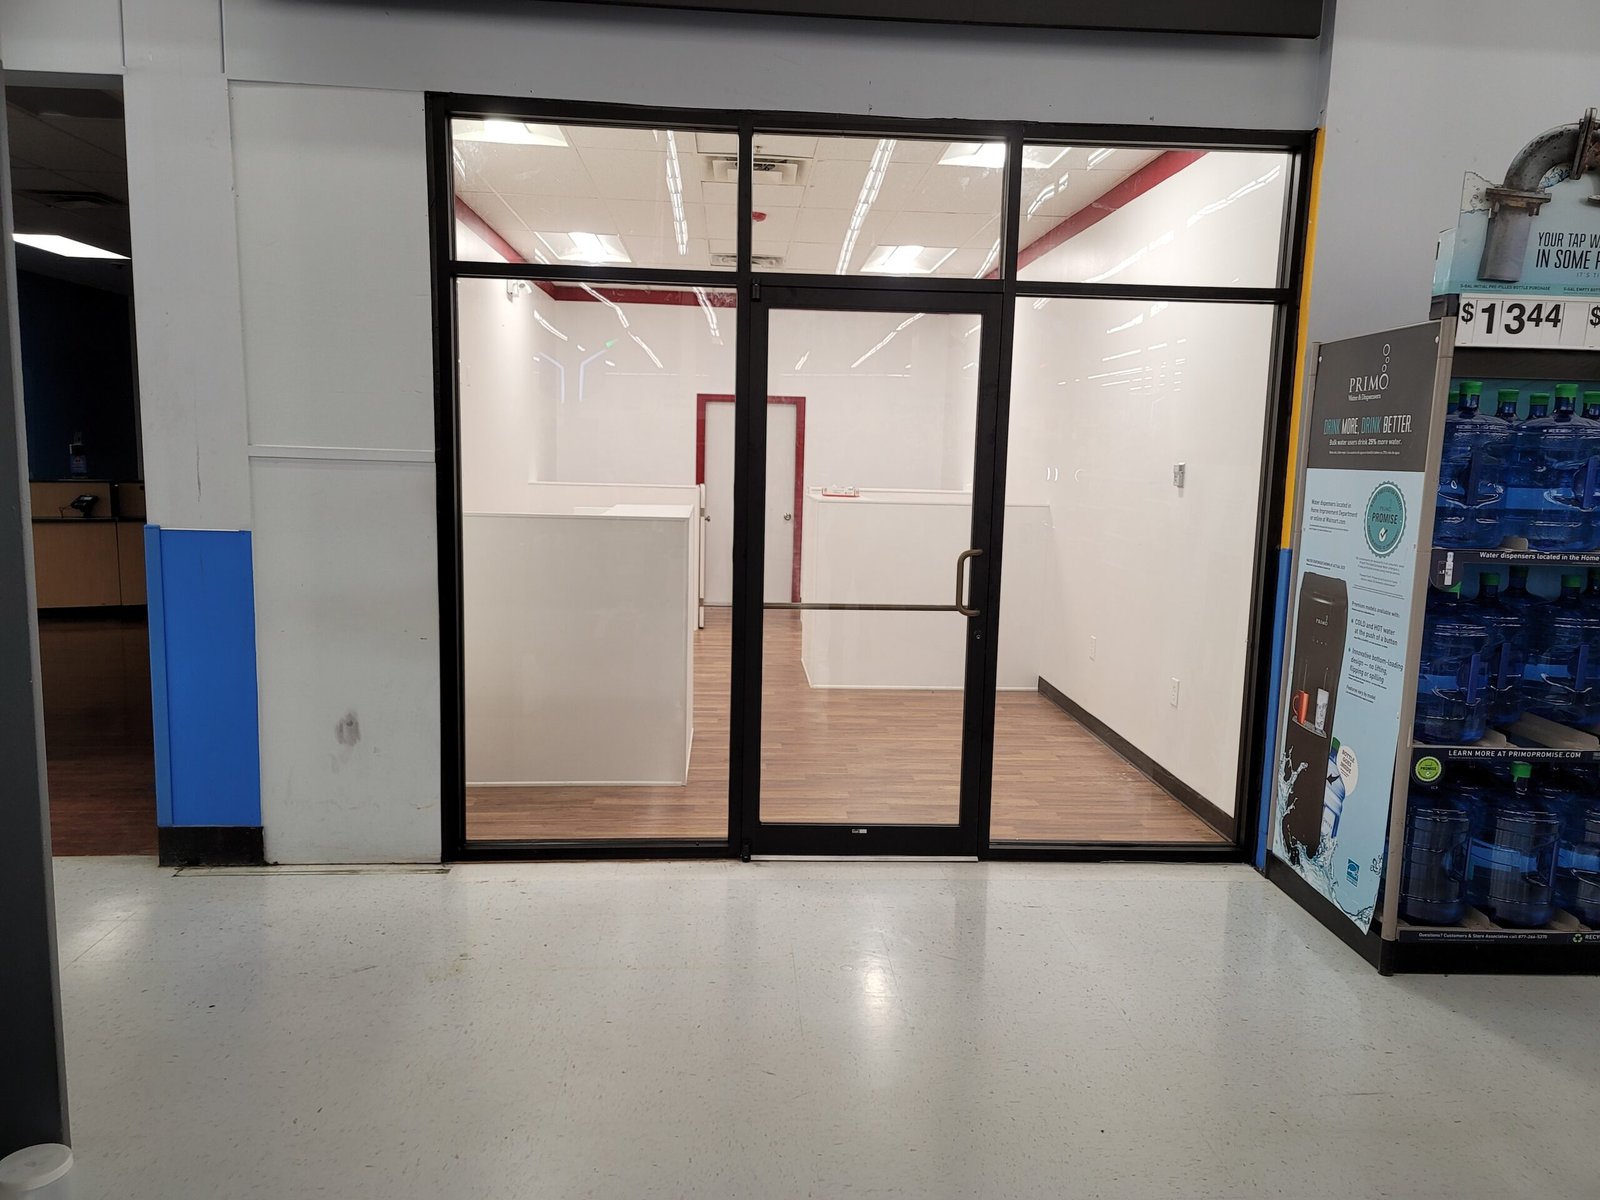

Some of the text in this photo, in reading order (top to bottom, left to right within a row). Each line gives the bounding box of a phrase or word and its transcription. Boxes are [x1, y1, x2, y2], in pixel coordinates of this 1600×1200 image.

[1538, 231, 1564, 247] YOUR
[1568, 233, 1586, 248] TAP
[1536, 249, 1551, 268] IN
[1554, 249, 1592, 270] SOME
[1348, 373, 1389, 393] PRIMO
[1323, 418, 1341, 435] DRINK
[1361, 416, 1382, 434] DRINK
[1382, 415, 1413, 434] BETTER.
[1371, 512, 1398, 525] PROMISE
[1500, 552, 1536, 561] dispensers
[1355, 618, 1366, 628] COLD
[1373, 624, 1383, 632] HOT
[1383, 627, 1395, 635] water
[1384, 637, 1398, 646] button
[1350, 656, 1364, 667] design
